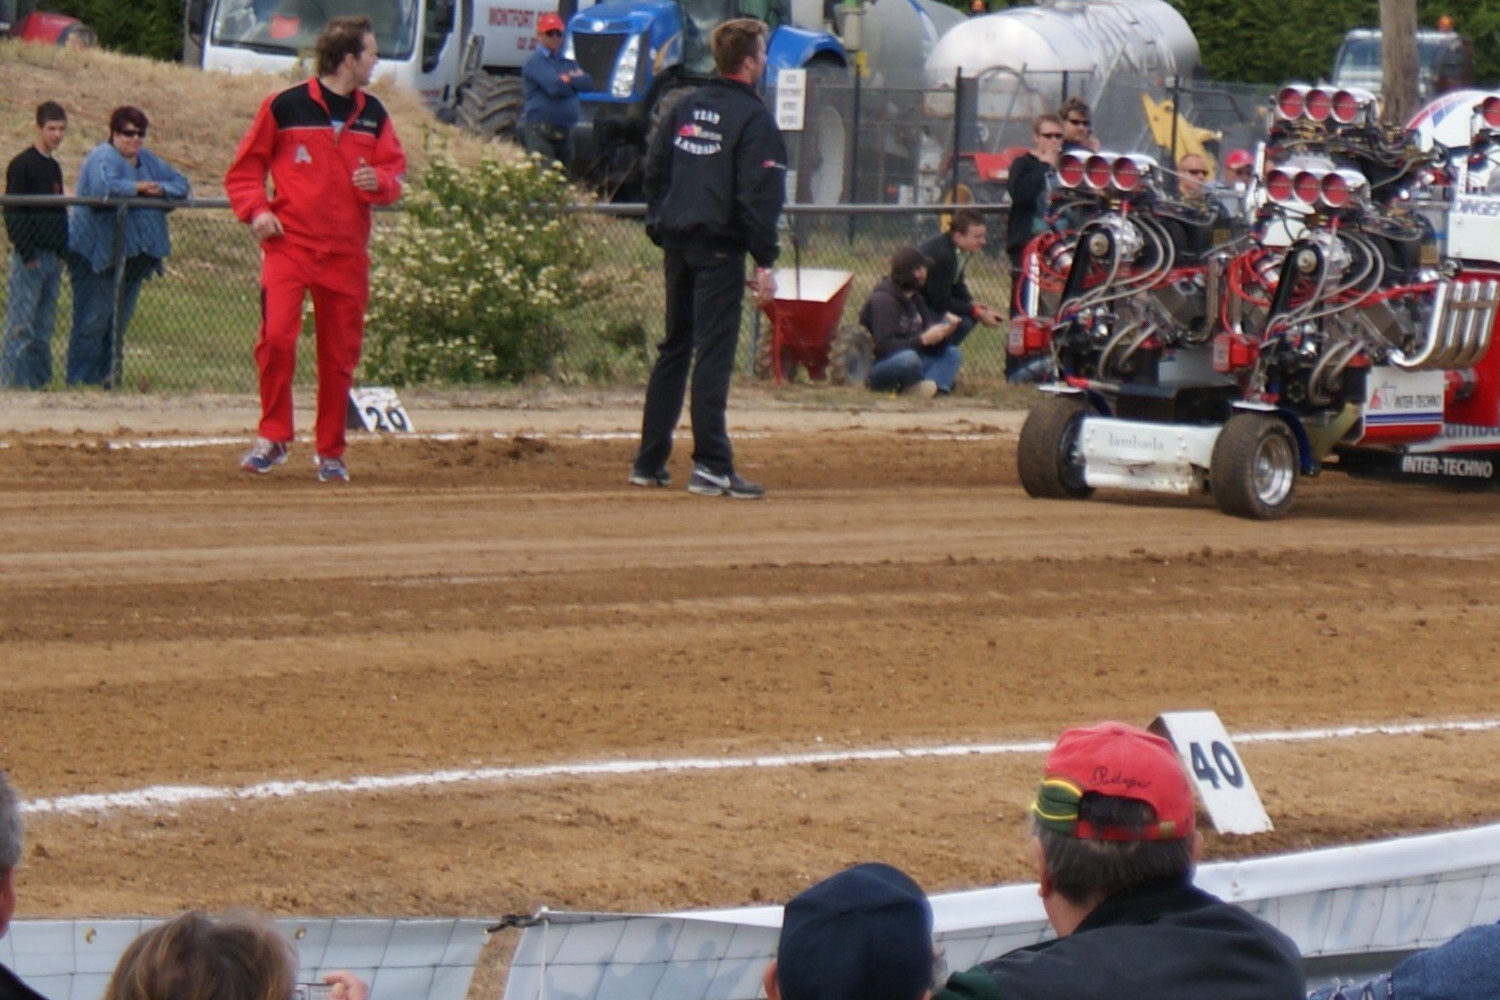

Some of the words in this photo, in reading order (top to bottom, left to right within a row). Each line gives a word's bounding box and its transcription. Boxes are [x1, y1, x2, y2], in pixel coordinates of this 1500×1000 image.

[366, 407, 408, 431] 20
[1402, 455, 1494, 478] INTER-TECHNO
[1189, 741, 1245, 789] 40
